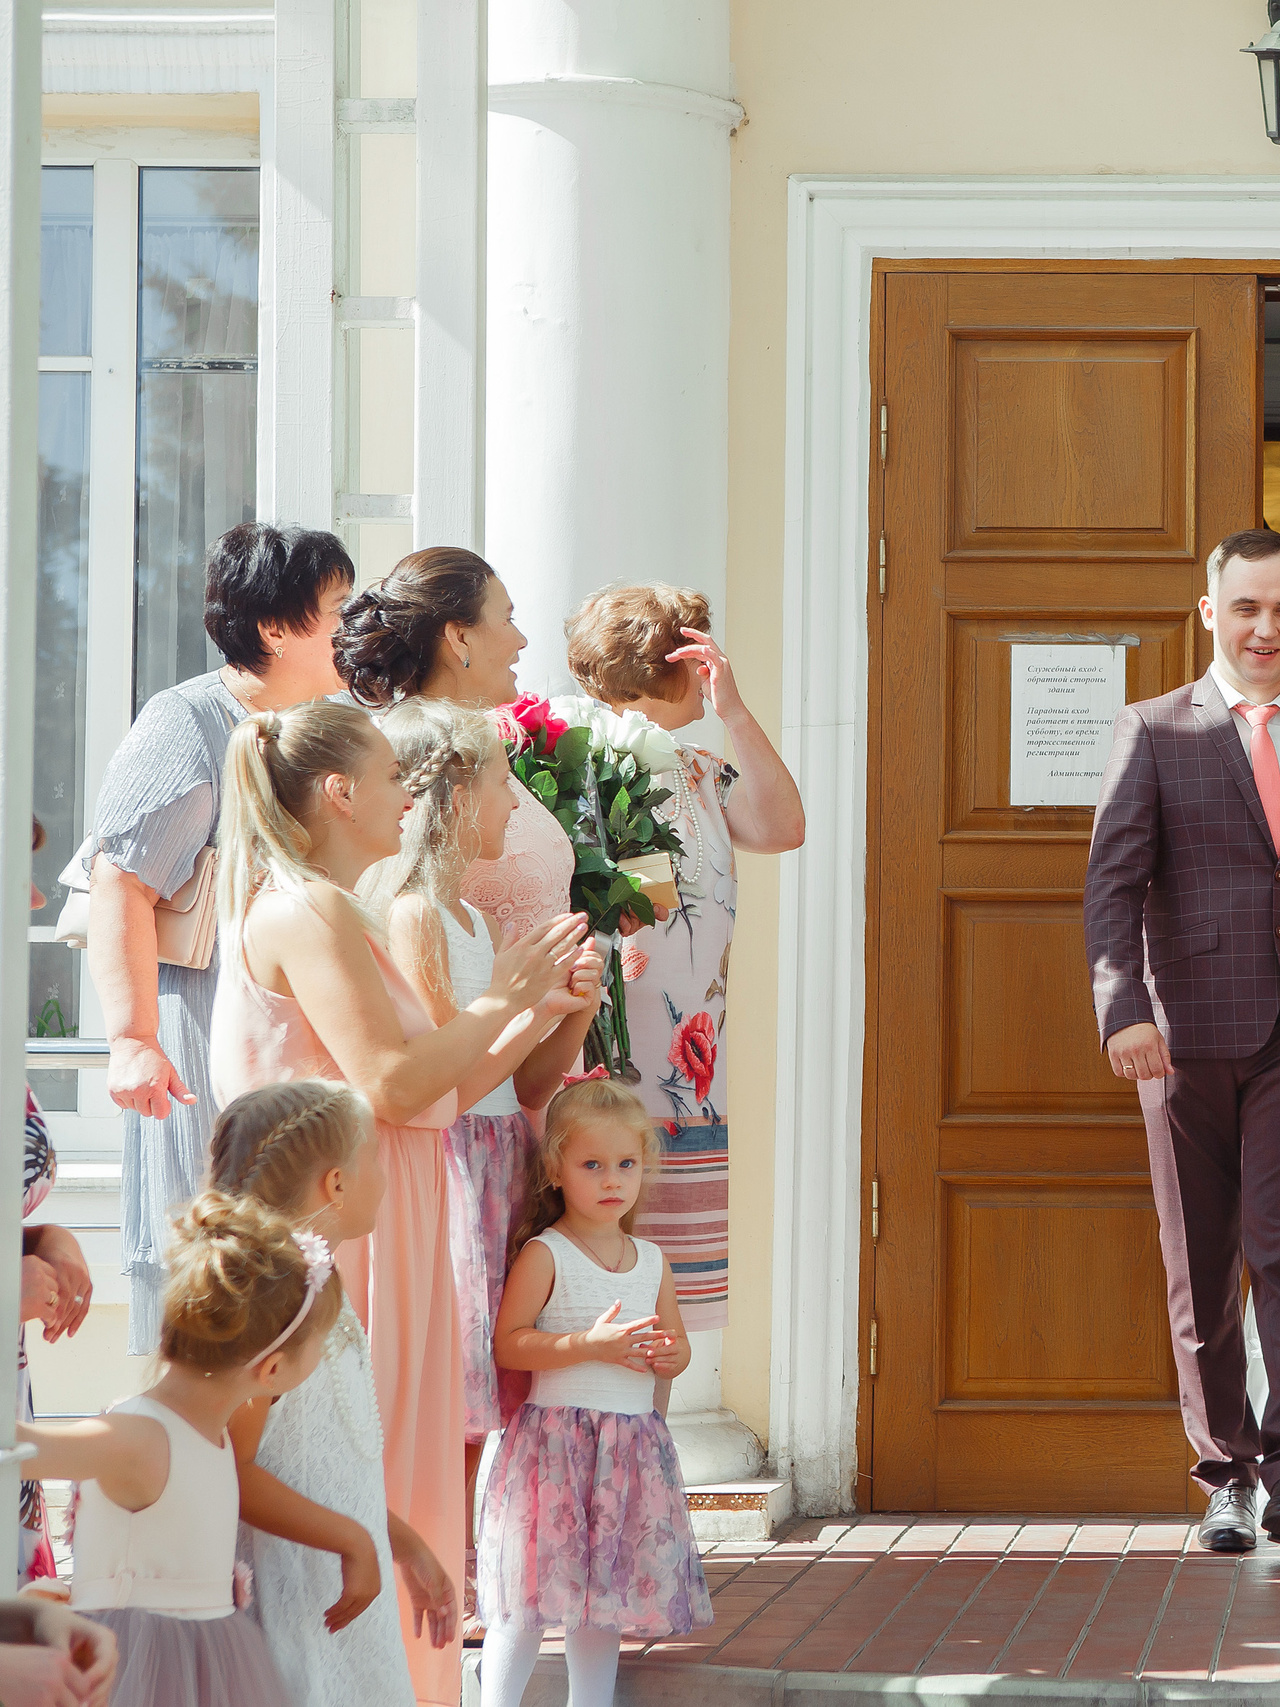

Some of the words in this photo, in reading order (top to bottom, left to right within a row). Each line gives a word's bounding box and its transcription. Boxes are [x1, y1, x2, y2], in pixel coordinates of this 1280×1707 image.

[1027, 665, 1076, 674] Служебный
[1078, 665, 1097, 673] вход
[1027, 676, 1068, 684] обратной
[1027, 707, 1069, 716] Парадный
[1026, 718, 1068, 726] работает
[1027, 728, 1062, 736] субботу,
[1027, 739, 1096, 747] торжественной
[1026, 750, 1080, 758] регистрации
